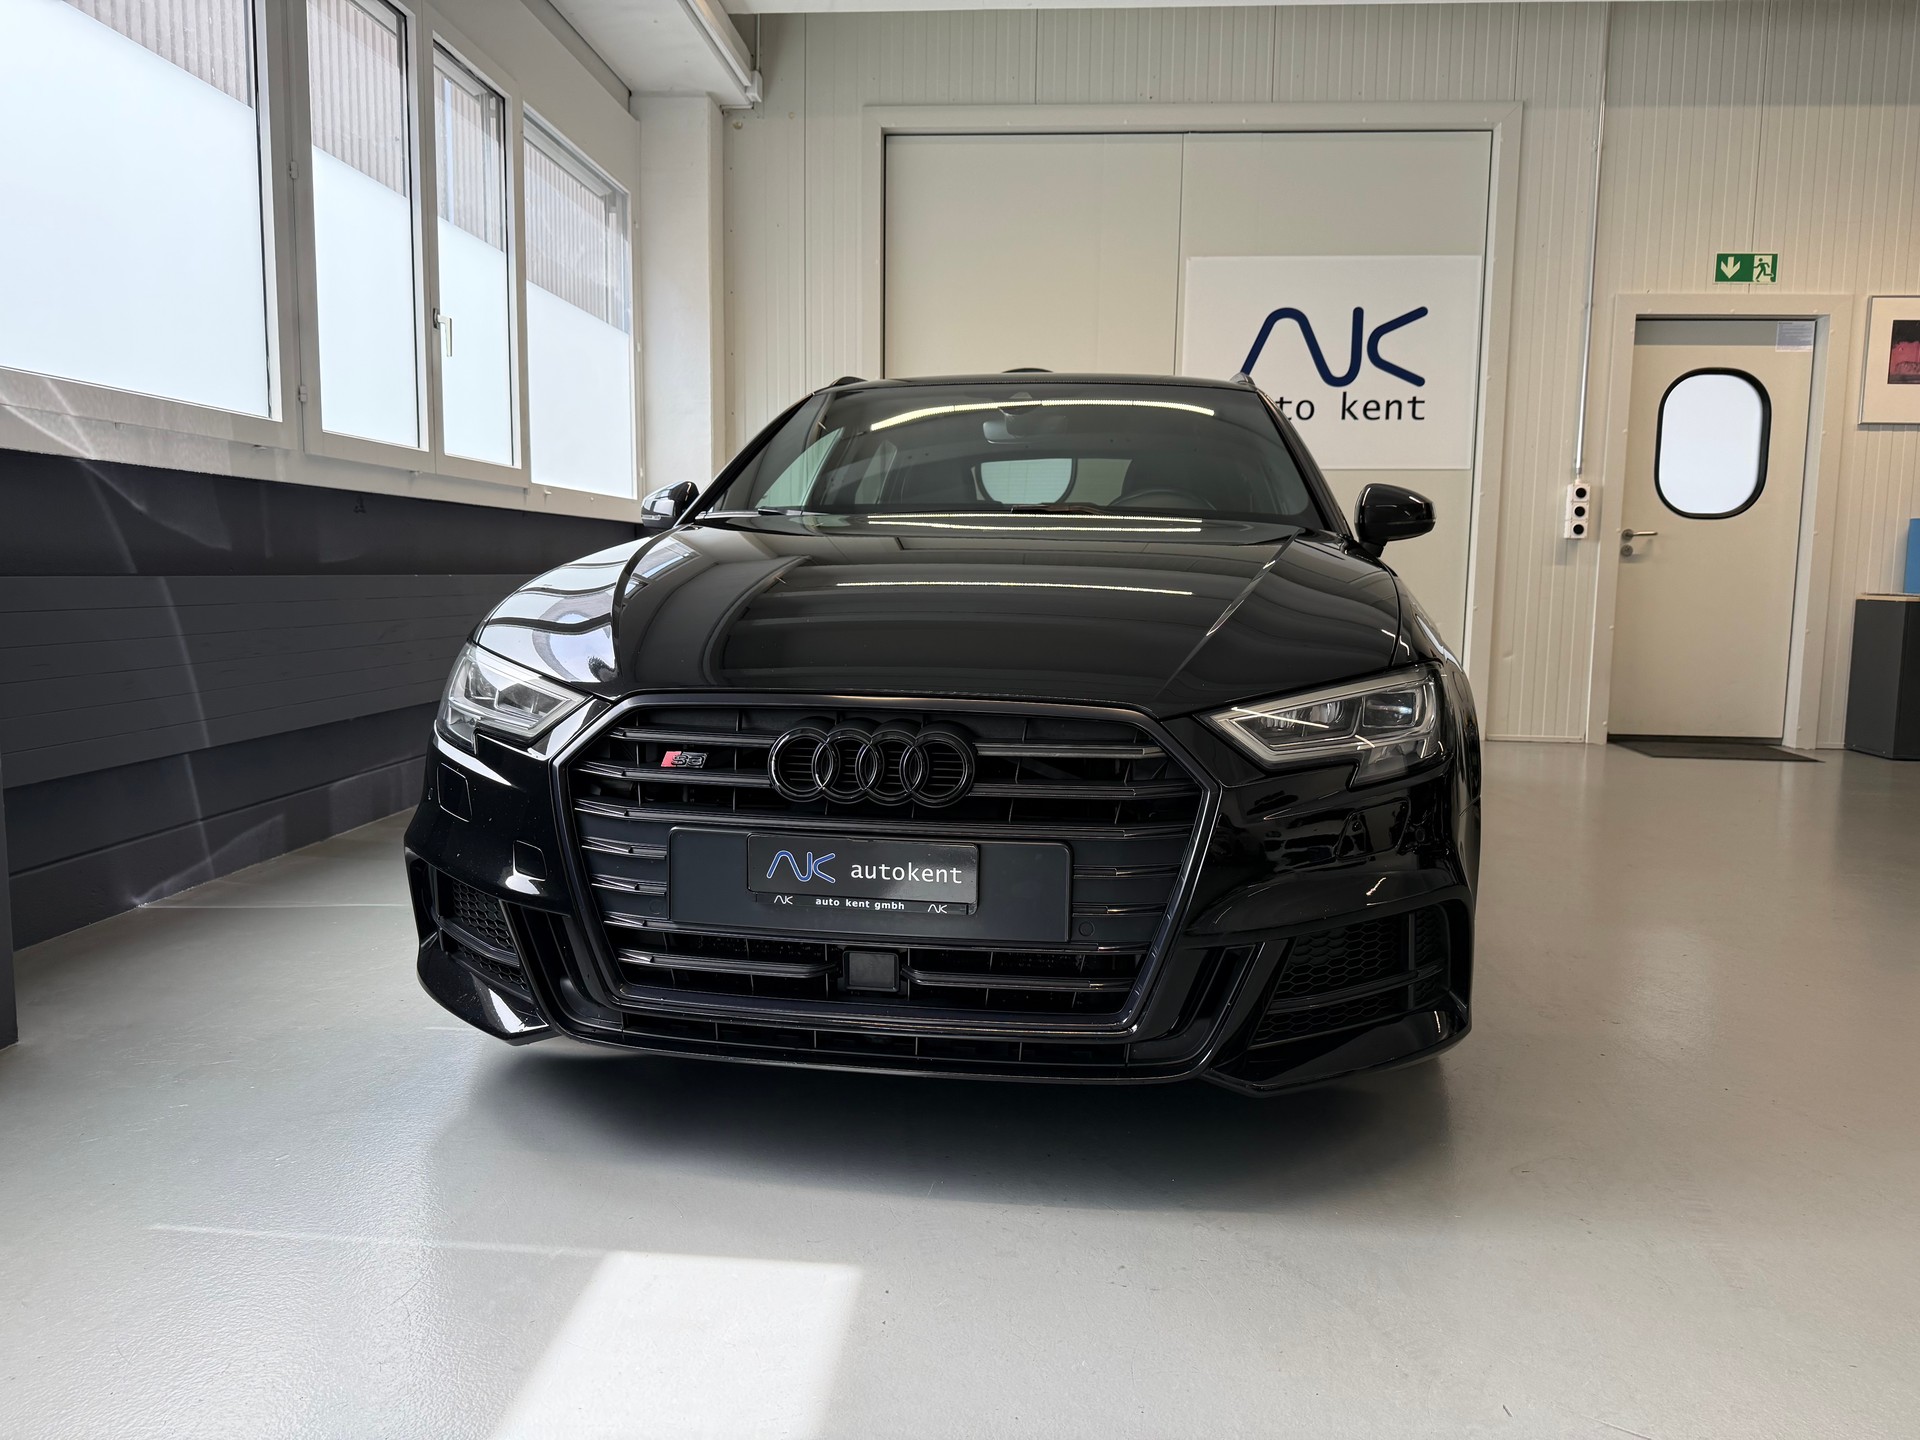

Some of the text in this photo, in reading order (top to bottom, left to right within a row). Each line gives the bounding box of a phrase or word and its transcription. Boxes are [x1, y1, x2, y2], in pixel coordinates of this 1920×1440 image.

[1275, 391, 1426, 421] to kent
[850, 861, 963, 885] autokent
[815, 897, 841, 907] auto
[845, 898, 871, 909] kent
[874, 901, 906, 911] gmbh
